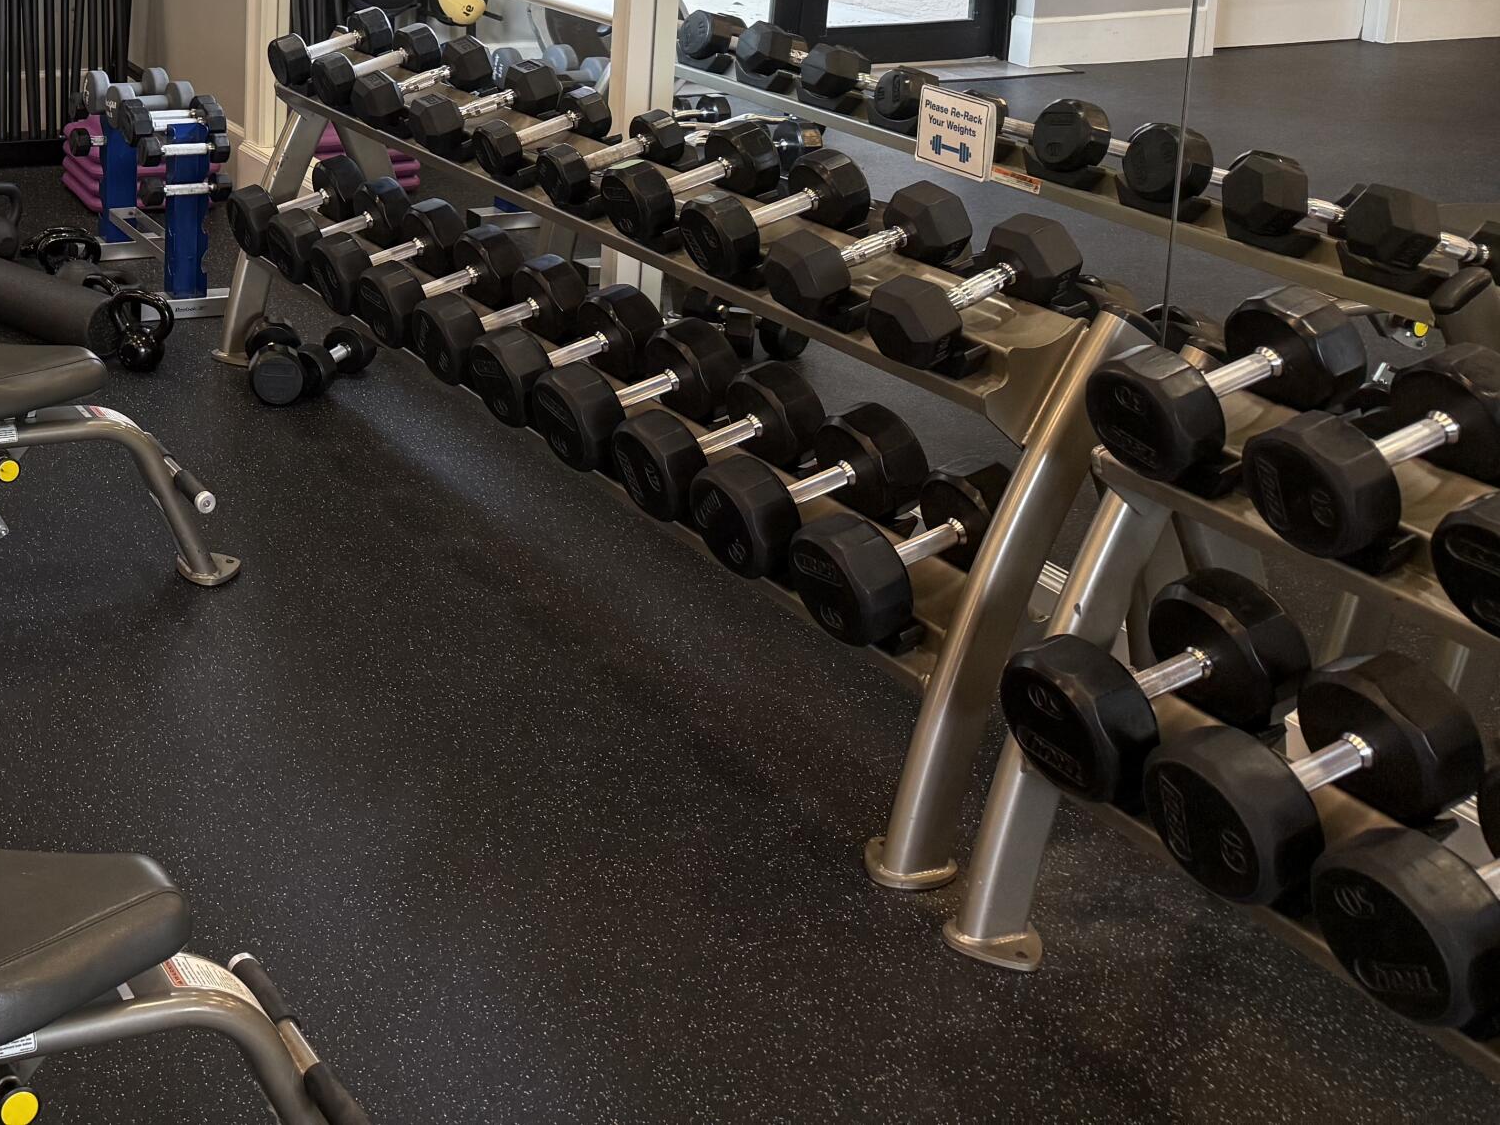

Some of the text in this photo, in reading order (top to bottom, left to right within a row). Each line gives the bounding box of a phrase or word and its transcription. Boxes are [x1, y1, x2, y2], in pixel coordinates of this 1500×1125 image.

[925, 99, 983, 125] Please Re-Rack
[928, 114, 977, 138] Your Weights
